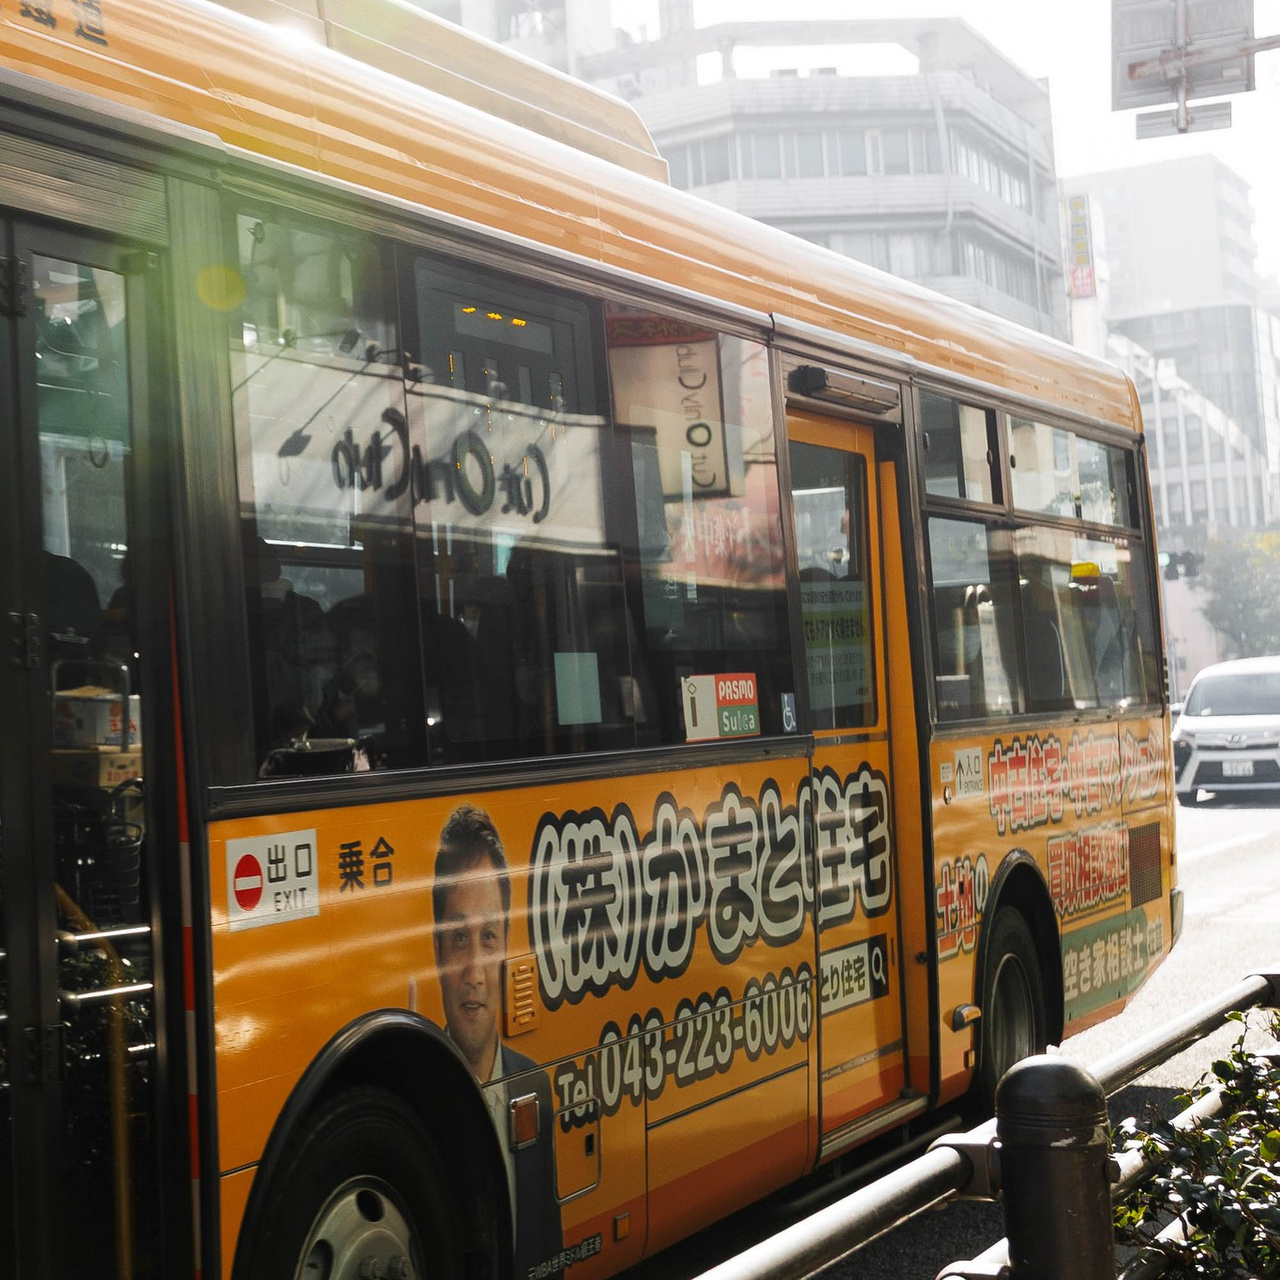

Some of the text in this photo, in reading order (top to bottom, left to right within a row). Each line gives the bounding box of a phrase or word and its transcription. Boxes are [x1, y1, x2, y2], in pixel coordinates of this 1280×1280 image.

[718, 679, 755, 701] PASMO
[722, 710, 755, 732] Suica
[965, 754, 981, 777] 入口
[267, 843, 312, 884] 出口
[338, 836, 395, 893] 乗合
[273, 887, 308, 913] EXIT
[600, 969, 813, 1108] 043-223-6006
